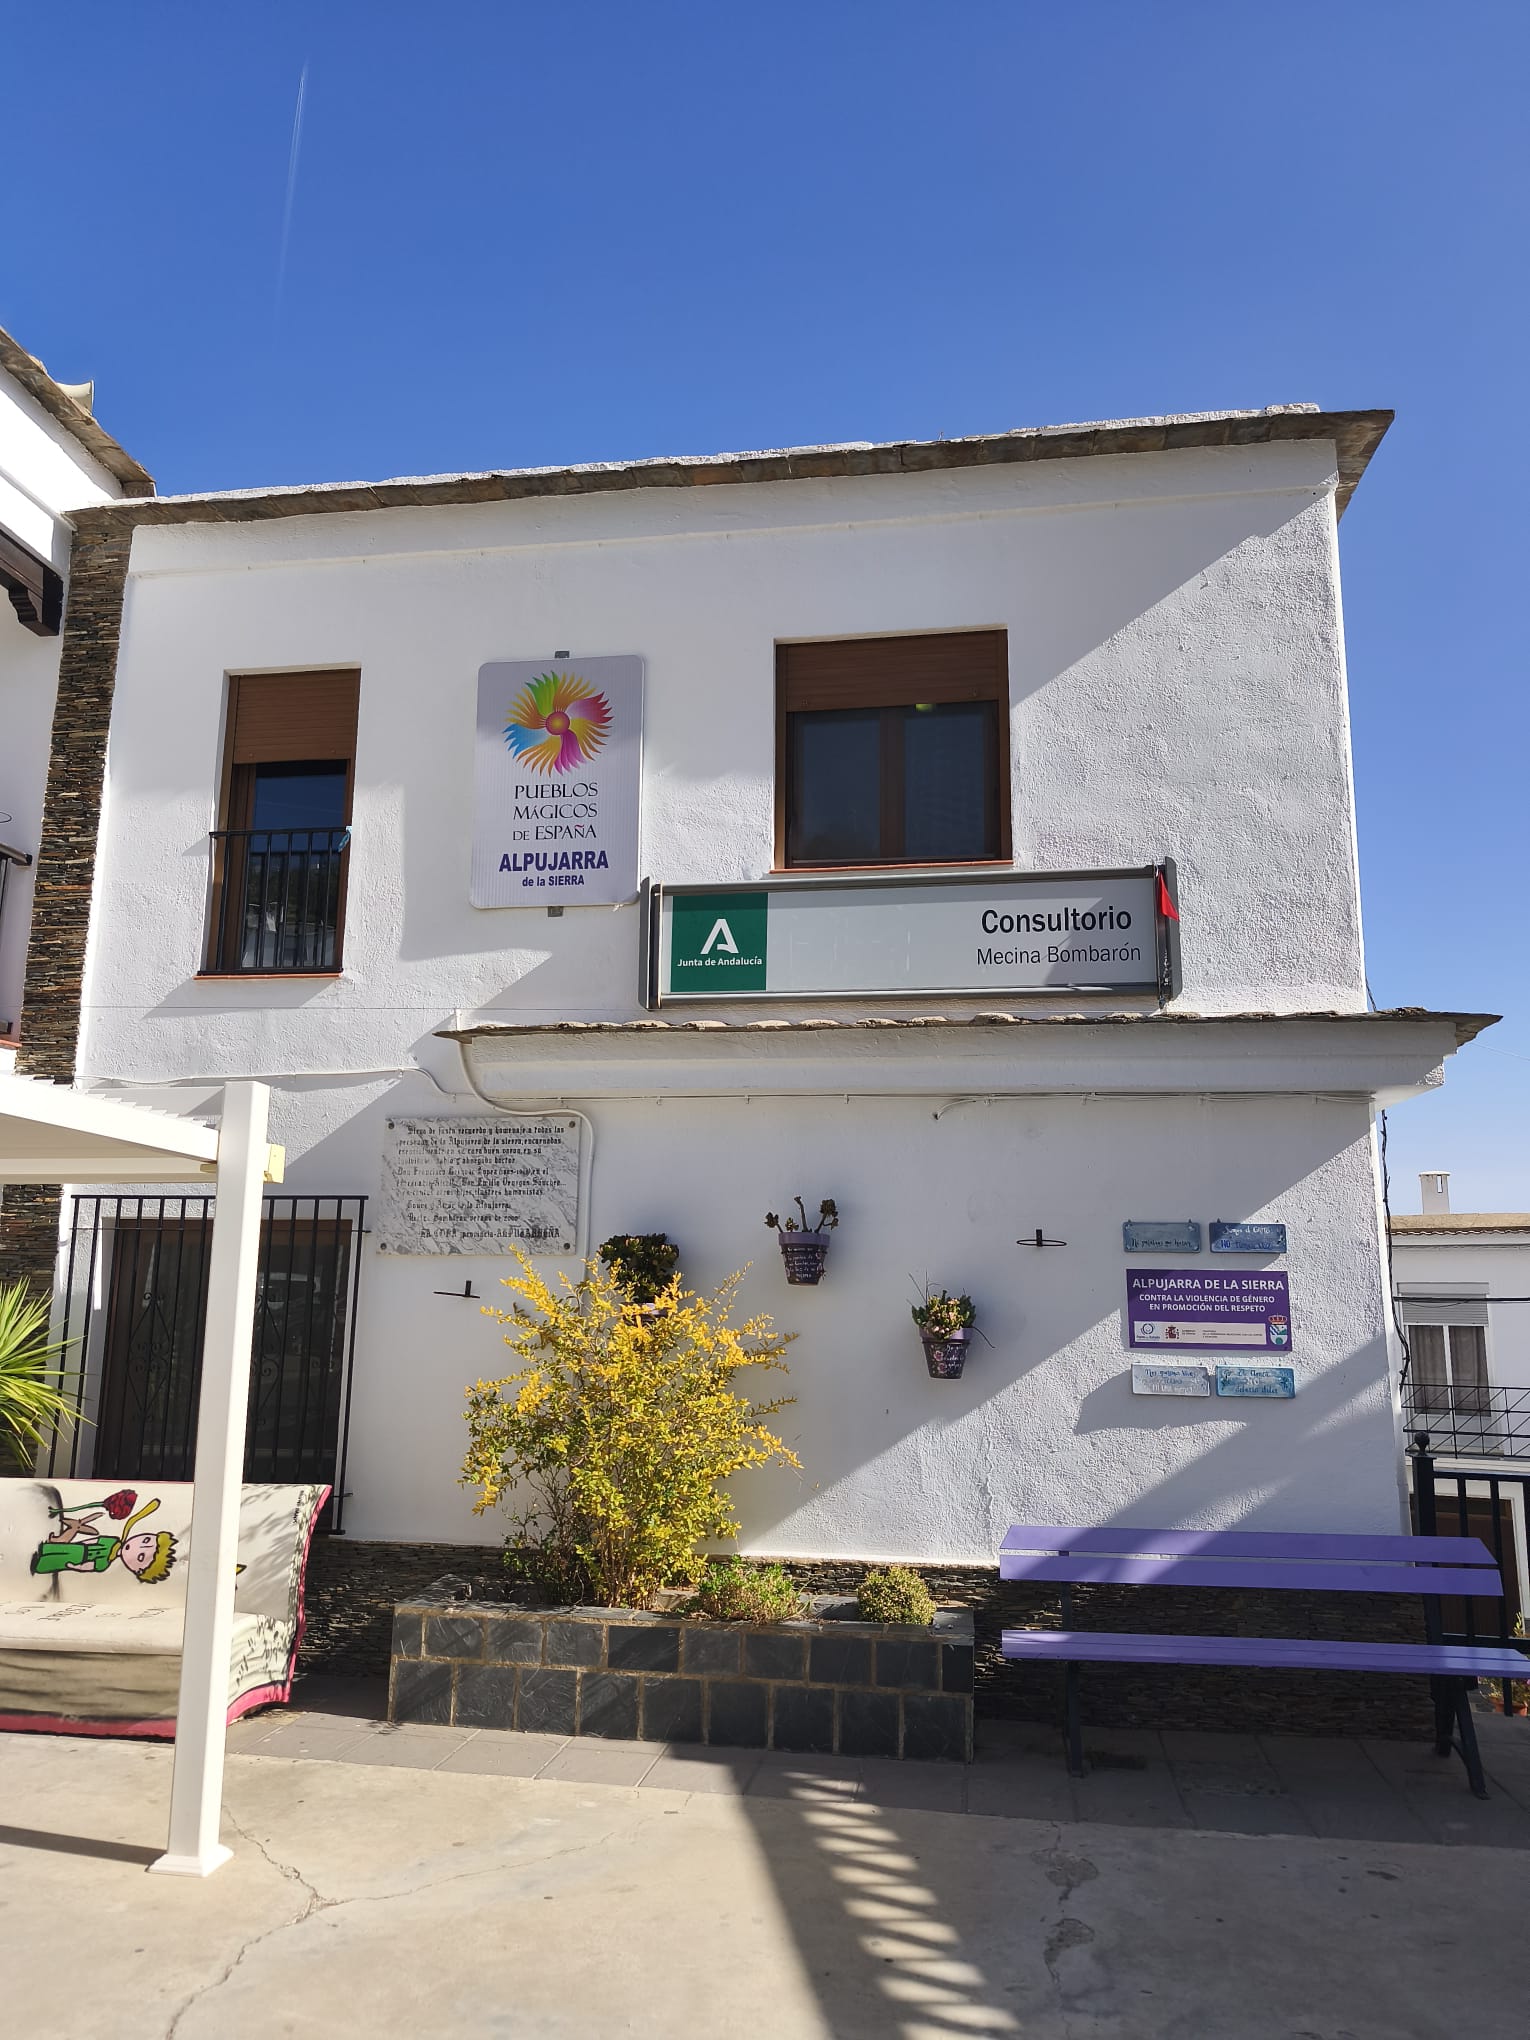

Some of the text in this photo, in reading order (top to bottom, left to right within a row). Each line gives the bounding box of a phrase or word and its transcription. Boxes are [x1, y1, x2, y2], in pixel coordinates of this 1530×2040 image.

[514, 782, 598, 799] PUEBLOS
[513, 803, 598, 820] MÁGICOS
[513, 824, 597, 841] DE ESPAÑA
[499, 850, 609, 872] ALPUJARRA
[522, 875, 585, 887] de la SIERRA
[981, 905, 1132, 934] Consultorio
[677, 955, 763, 967] Junta de Andalucía
[977, 942, 1142, 966] Mecina Bombarón
[1133, 1278, 1284, 1291] ALPUJARRA DE LA SIERRA
[1174, 1294, 1184, 1302] LA
[1186, 1294, 1228, 1302] VIOLENCIA
[1230, 1295, 1241, 1303] DE
[1242, 1294, 1275, 1303] GÉNERO
[1162, 1303, 1213, 1312] PROMOCIÓN
